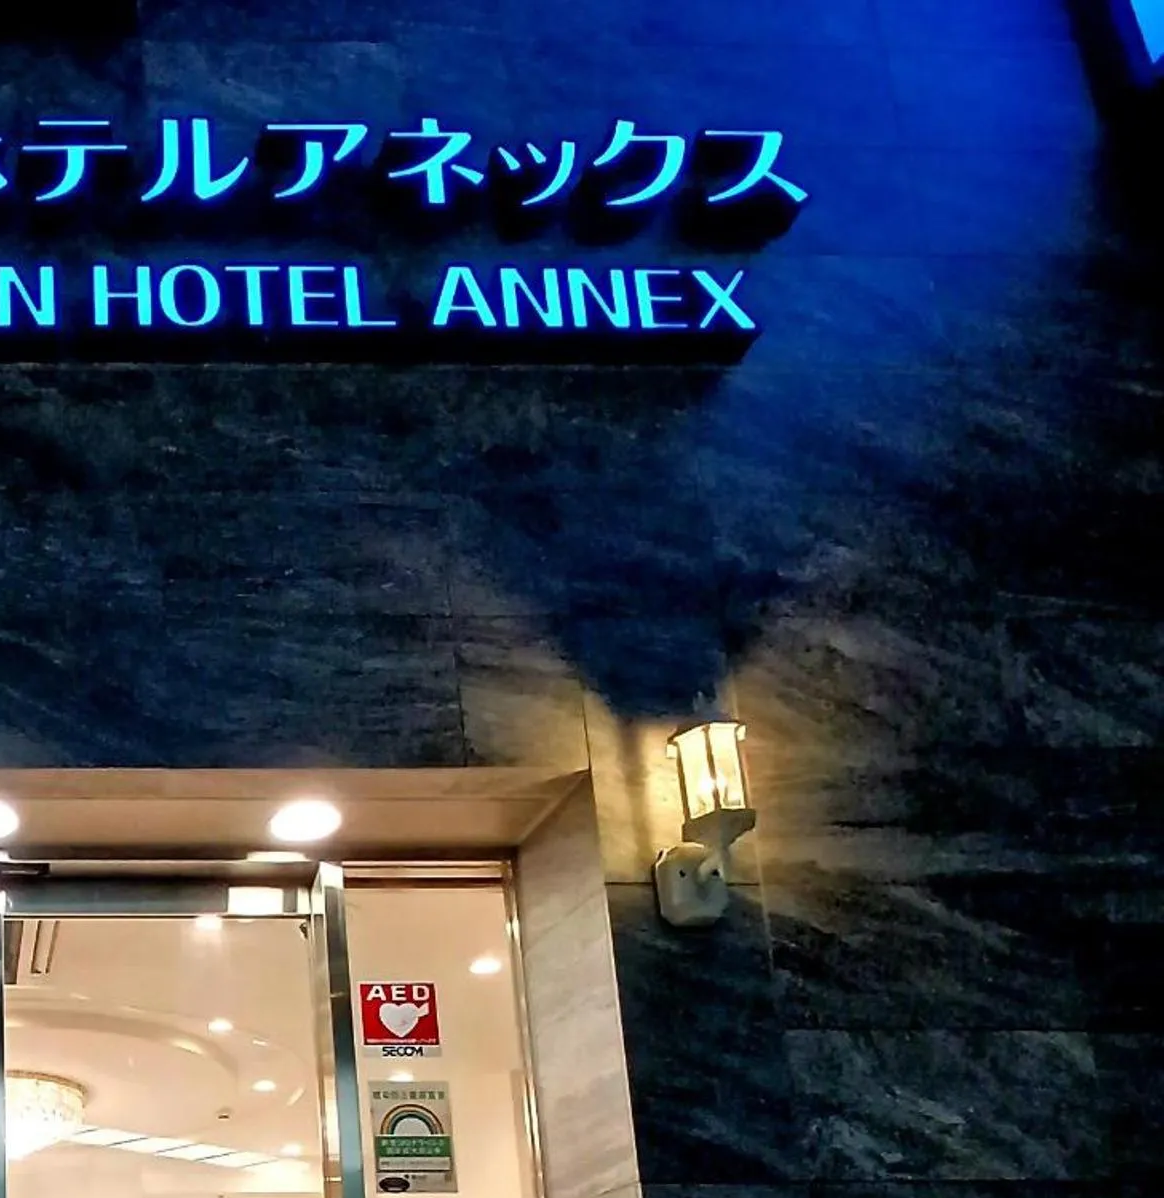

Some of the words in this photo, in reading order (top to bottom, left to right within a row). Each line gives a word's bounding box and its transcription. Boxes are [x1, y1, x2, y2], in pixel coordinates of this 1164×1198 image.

[93, 265, 396, 327] HOTEL
[433, 266, 755, 329] ANNEX
[366, 985, 430, 1001] AED
[382, 1046, 424, 1057] SECOM
